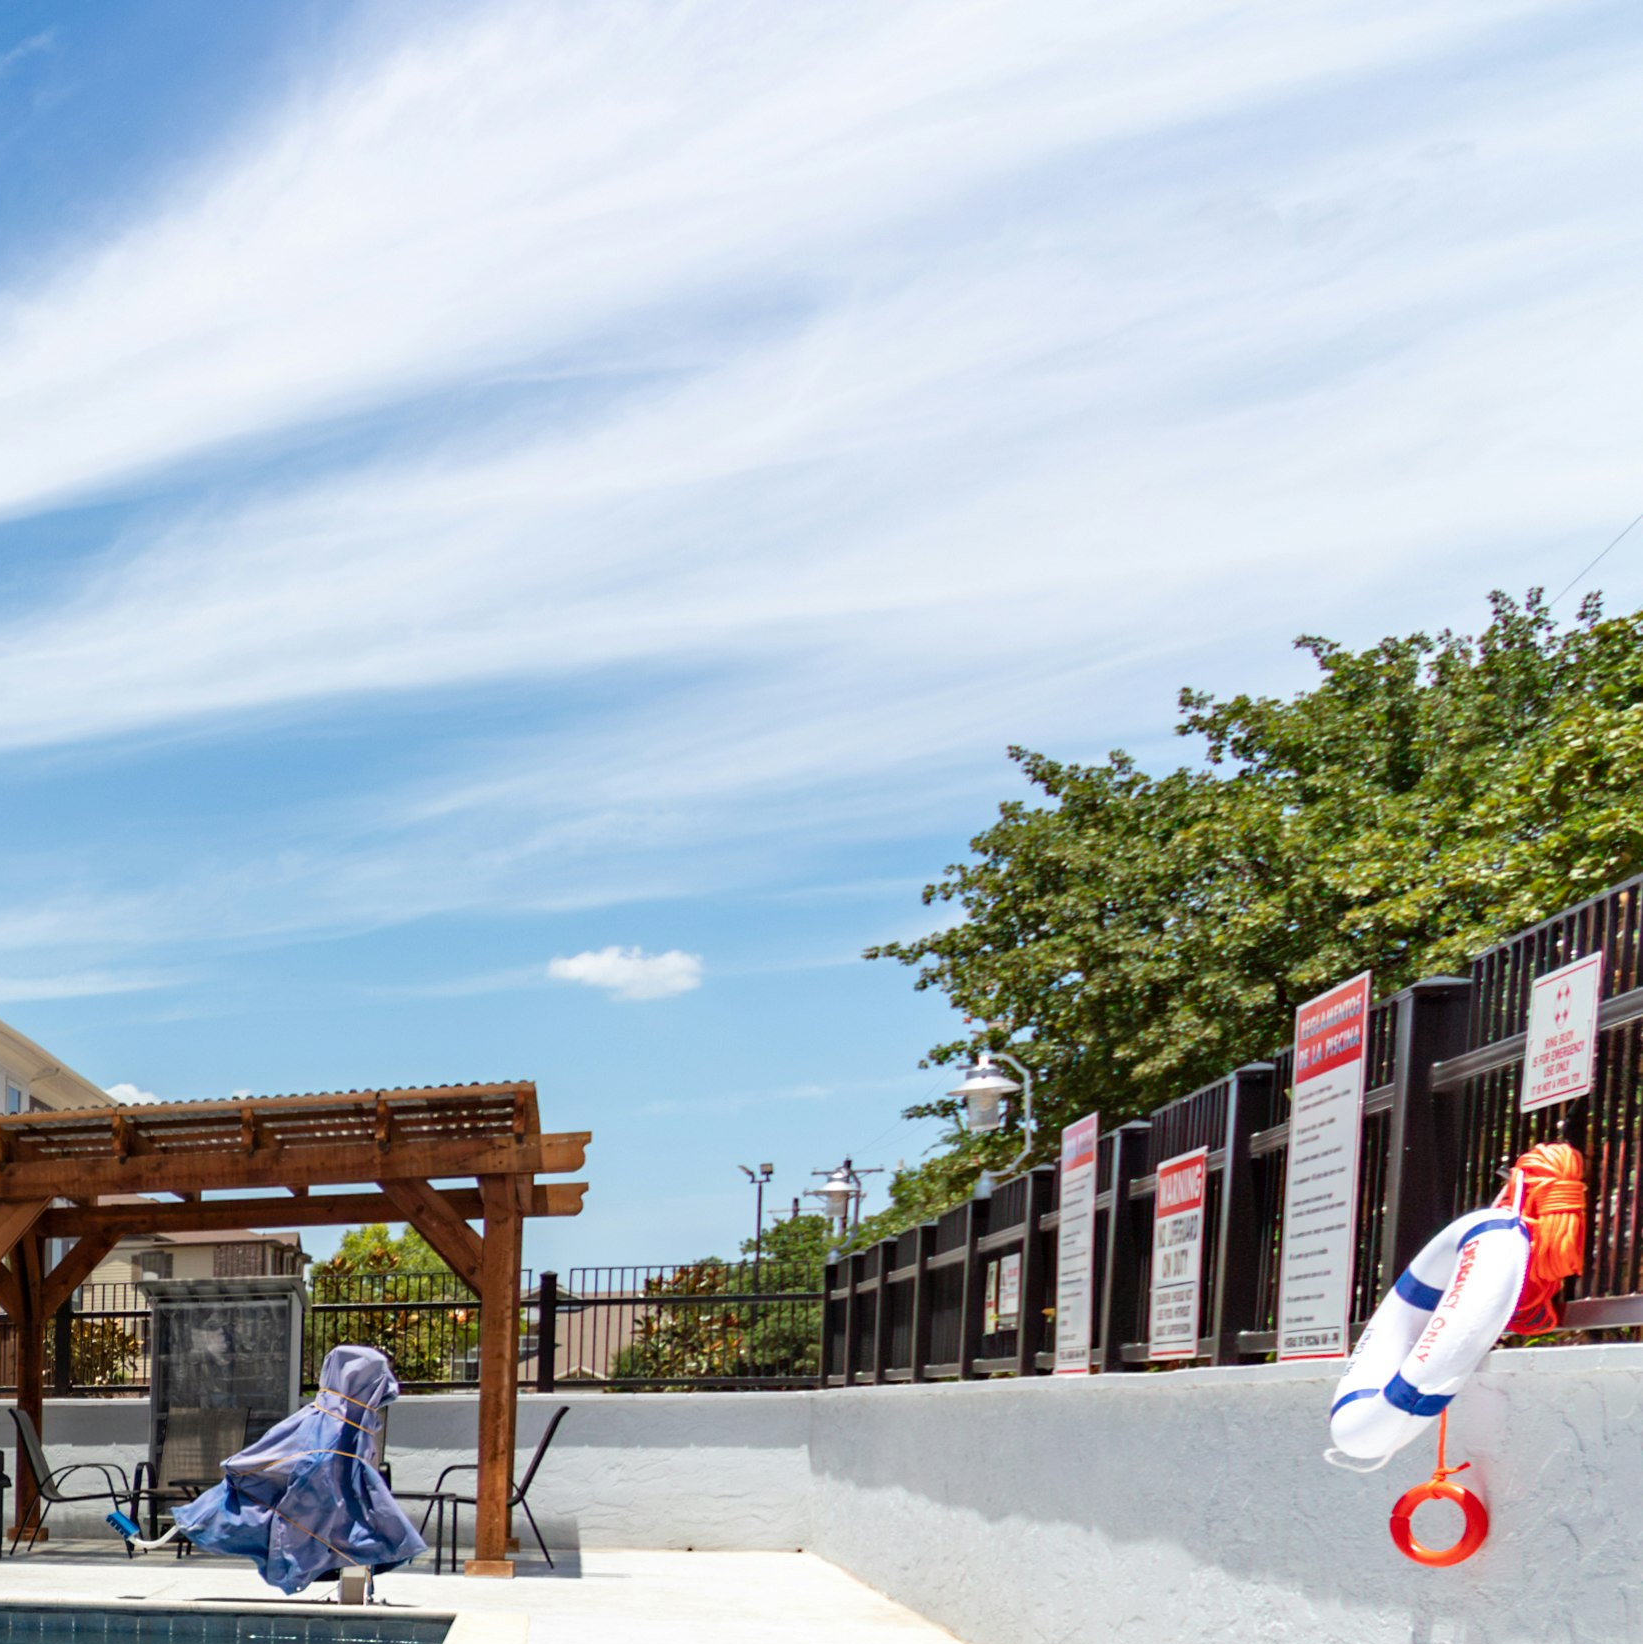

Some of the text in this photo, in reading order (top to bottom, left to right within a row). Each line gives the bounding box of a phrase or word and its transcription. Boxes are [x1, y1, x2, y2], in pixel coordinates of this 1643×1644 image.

[1300, 992, 1362, 1040] REGLAMENTOS
[1298, 1024, 1360, 1070] DE LA PISCINA
[1539, 1053, 1549, 1066] FOR
[1551, 1040, 1585, 1062] EMERGENCY
[1545, 1036, 1557, 1049] RING
[1543, 1060, 1570, 1078] USE ONLY
[1159, 1163, 1202, 1208] WARNING
[1162, 1248, 1189, 1279] ON DUTY
[1416, 1240, 1479, 1363] EMERGENCY ONLY
